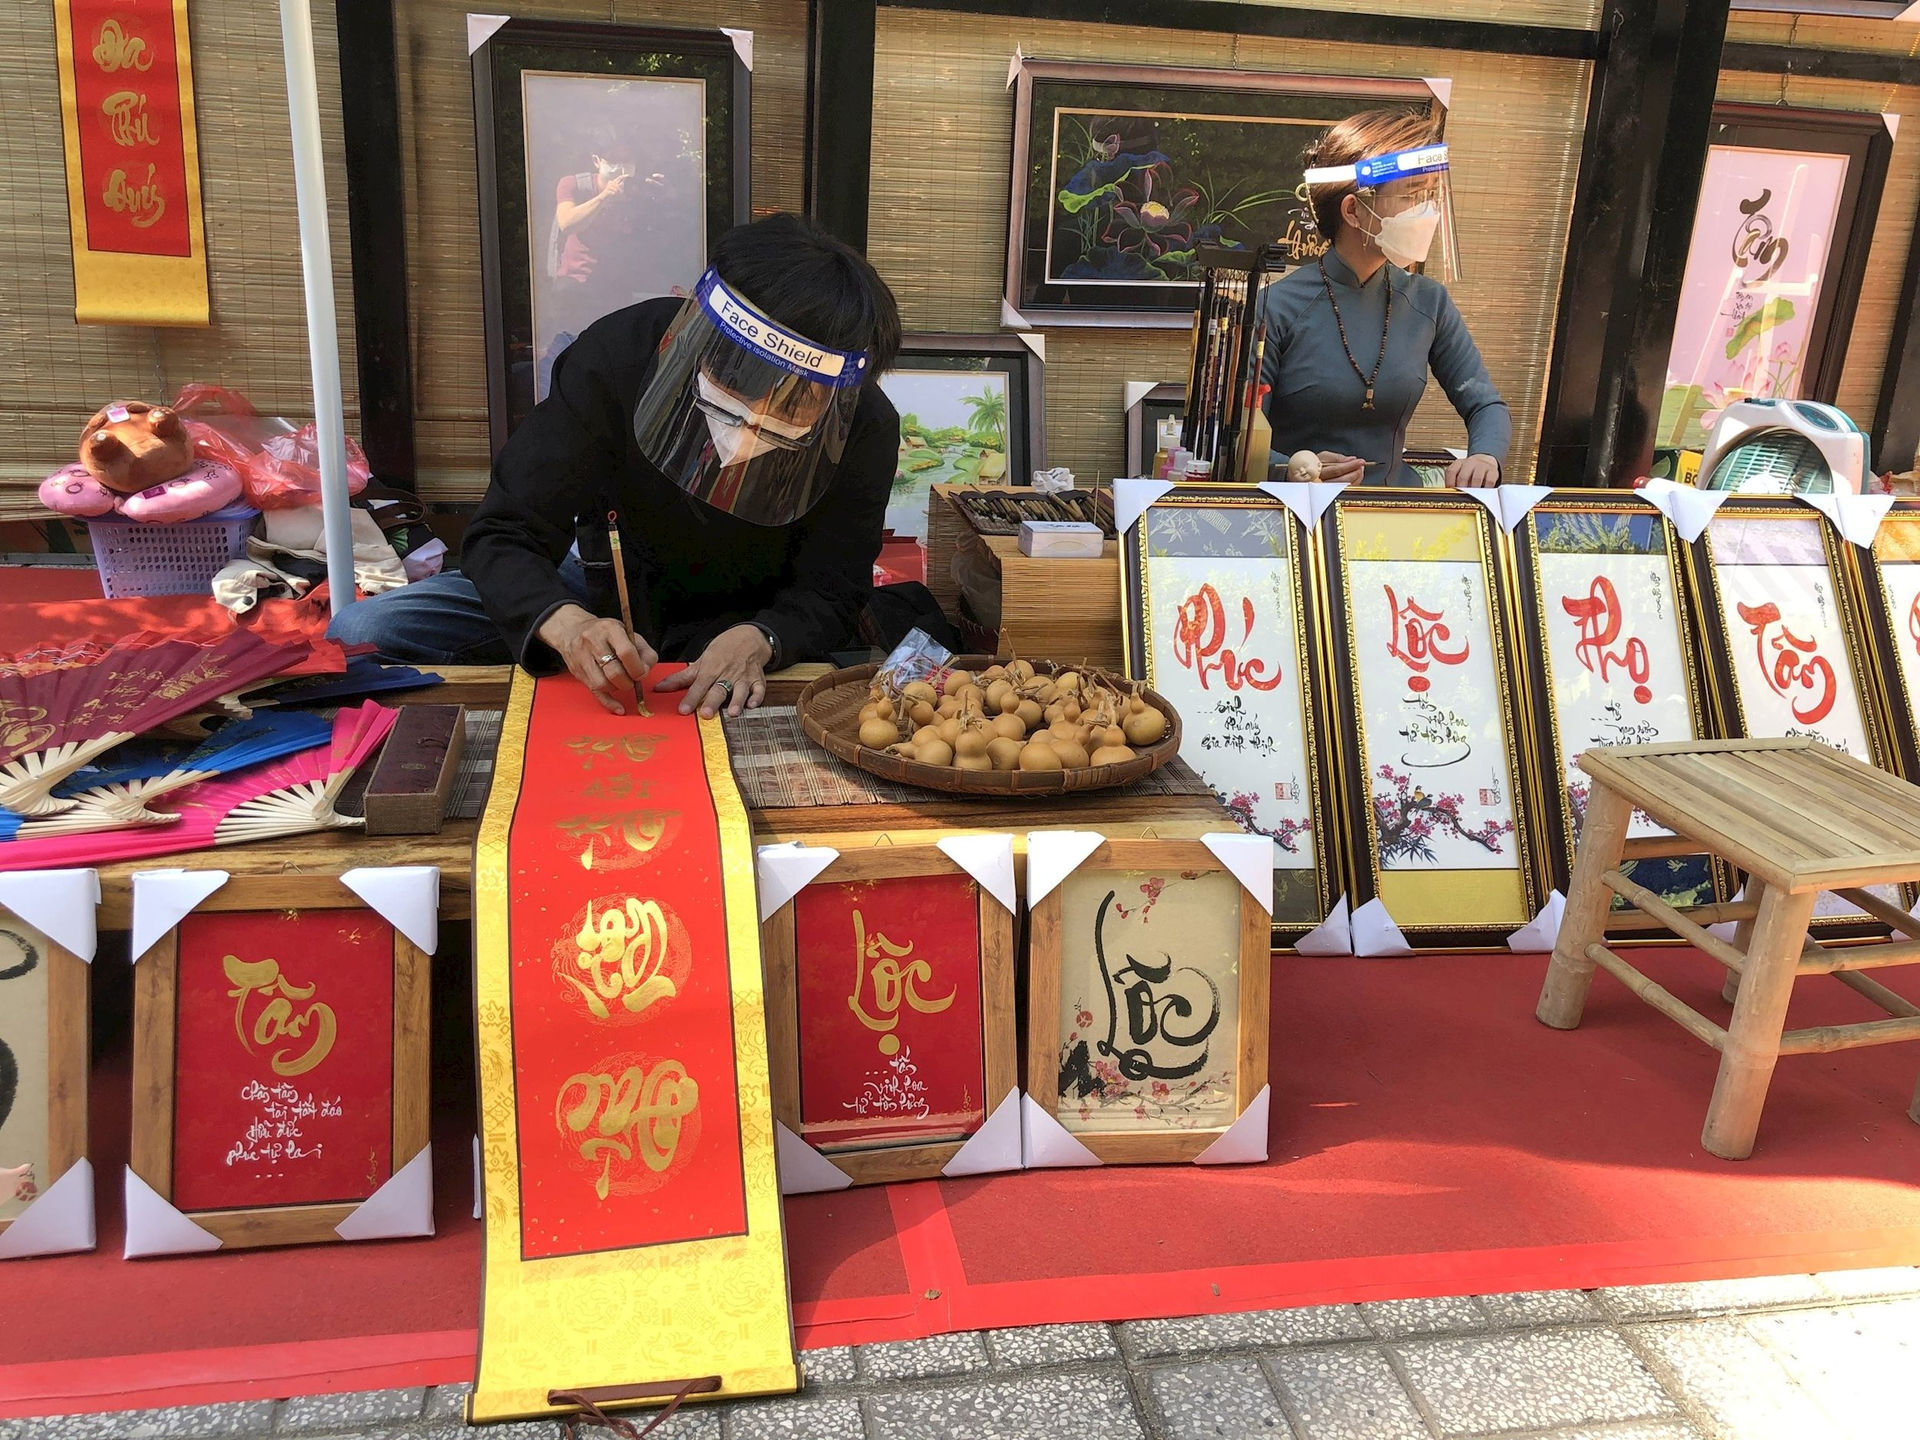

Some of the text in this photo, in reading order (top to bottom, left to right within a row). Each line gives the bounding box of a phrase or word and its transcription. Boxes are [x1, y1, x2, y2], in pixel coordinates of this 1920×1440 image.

[719, 320, 753, 350] Protective
[786, 363, 809, 377] Mask
[720, 300, 759, 338] Face
[763, 332, 823, 368] Shield
[222, 954, 337, 1077] Tâm
[848, 909, 957, 1057] Lộc
[1094, 889, 1221, 1081] Lộc
